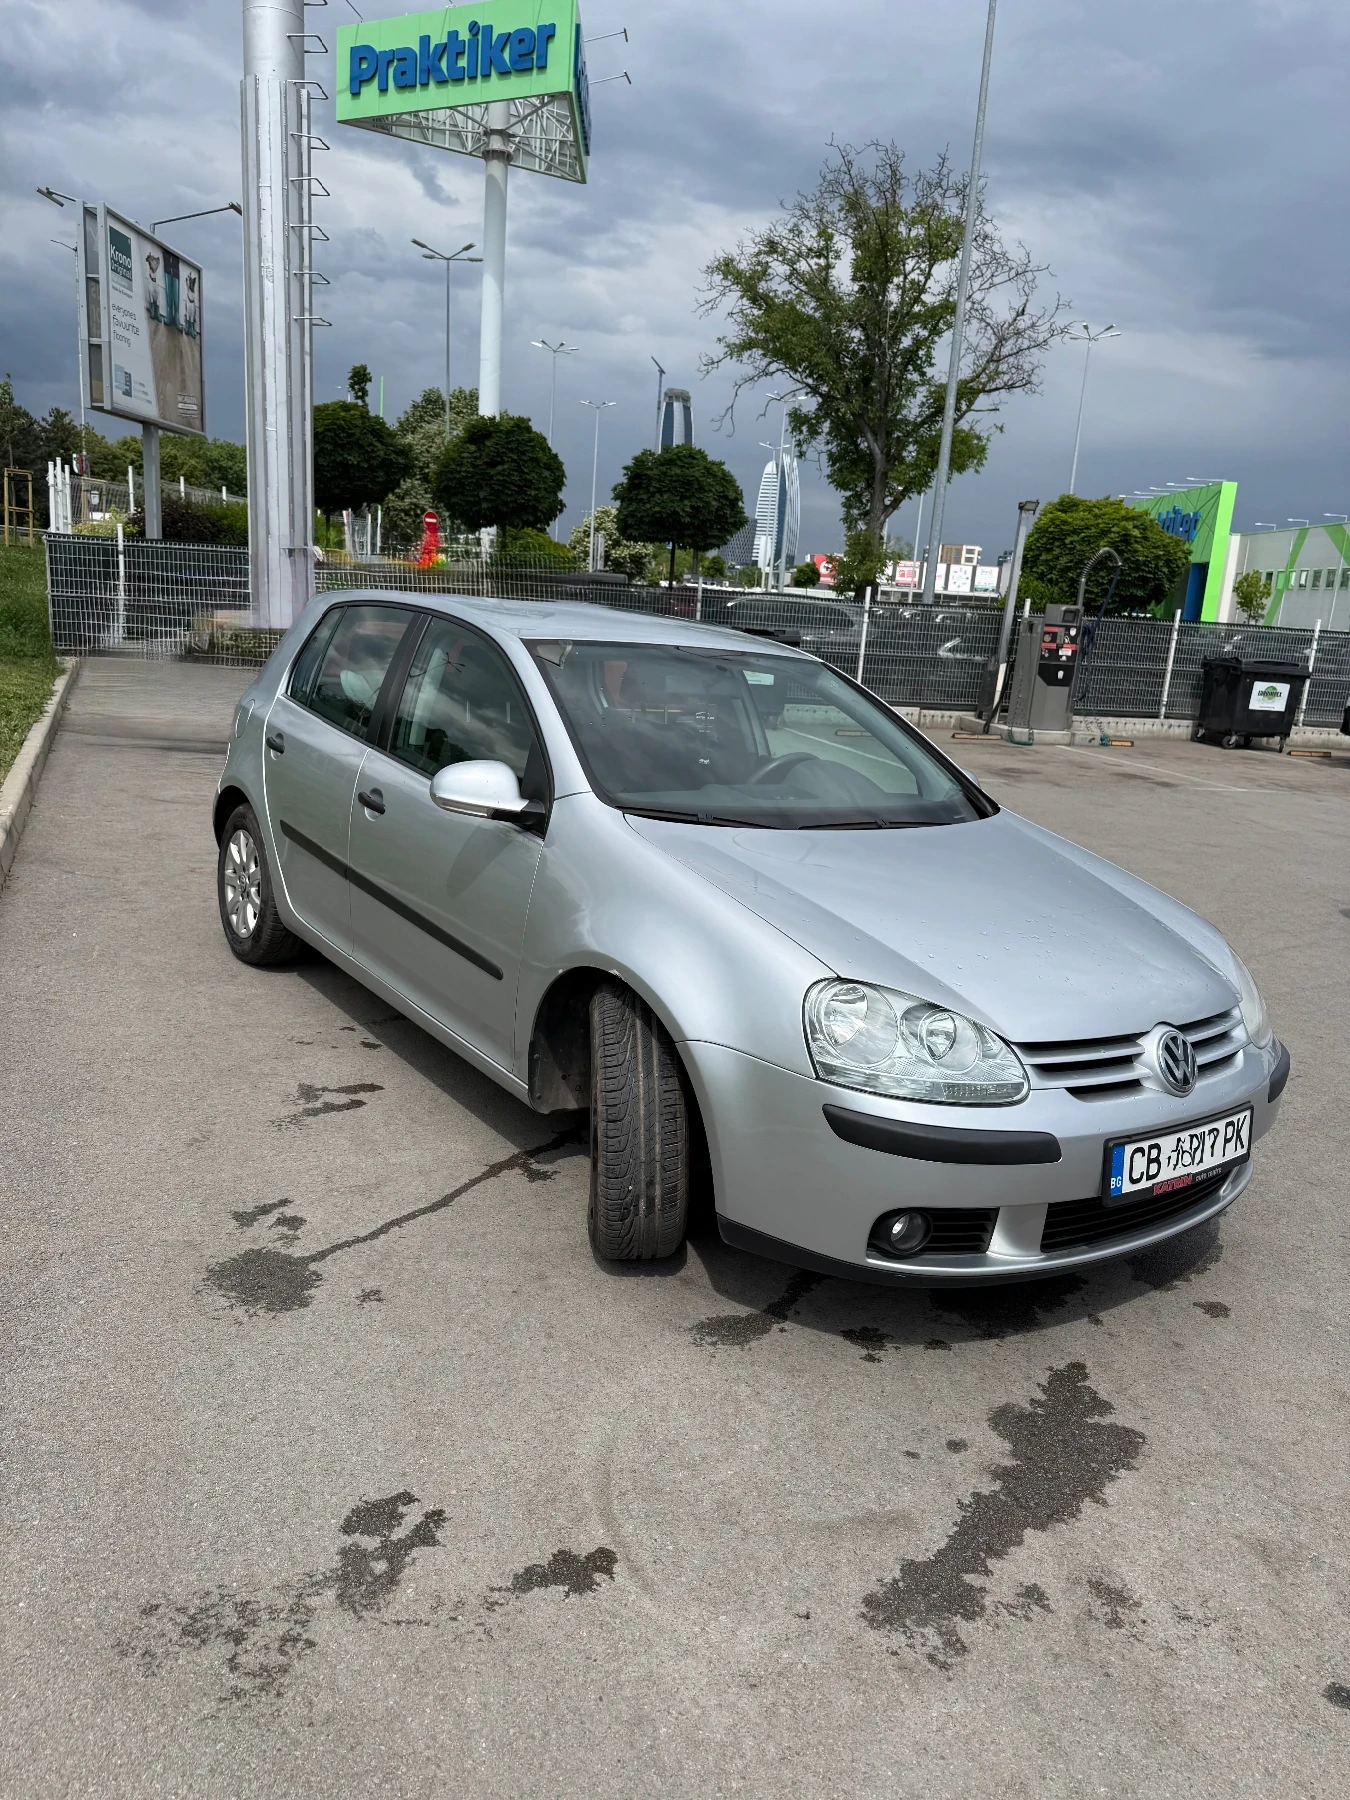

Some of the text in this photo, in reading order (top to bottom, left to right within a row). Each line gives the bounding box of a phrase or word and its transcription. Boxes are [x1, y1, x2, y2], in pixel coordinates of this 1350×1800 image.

[349, 20, 556, 95] Praktiker
[110, 244, 132, 269] Krono
[112, 314, 140, 336] favourite
[1110, 1176, 1122, 1189] BG
